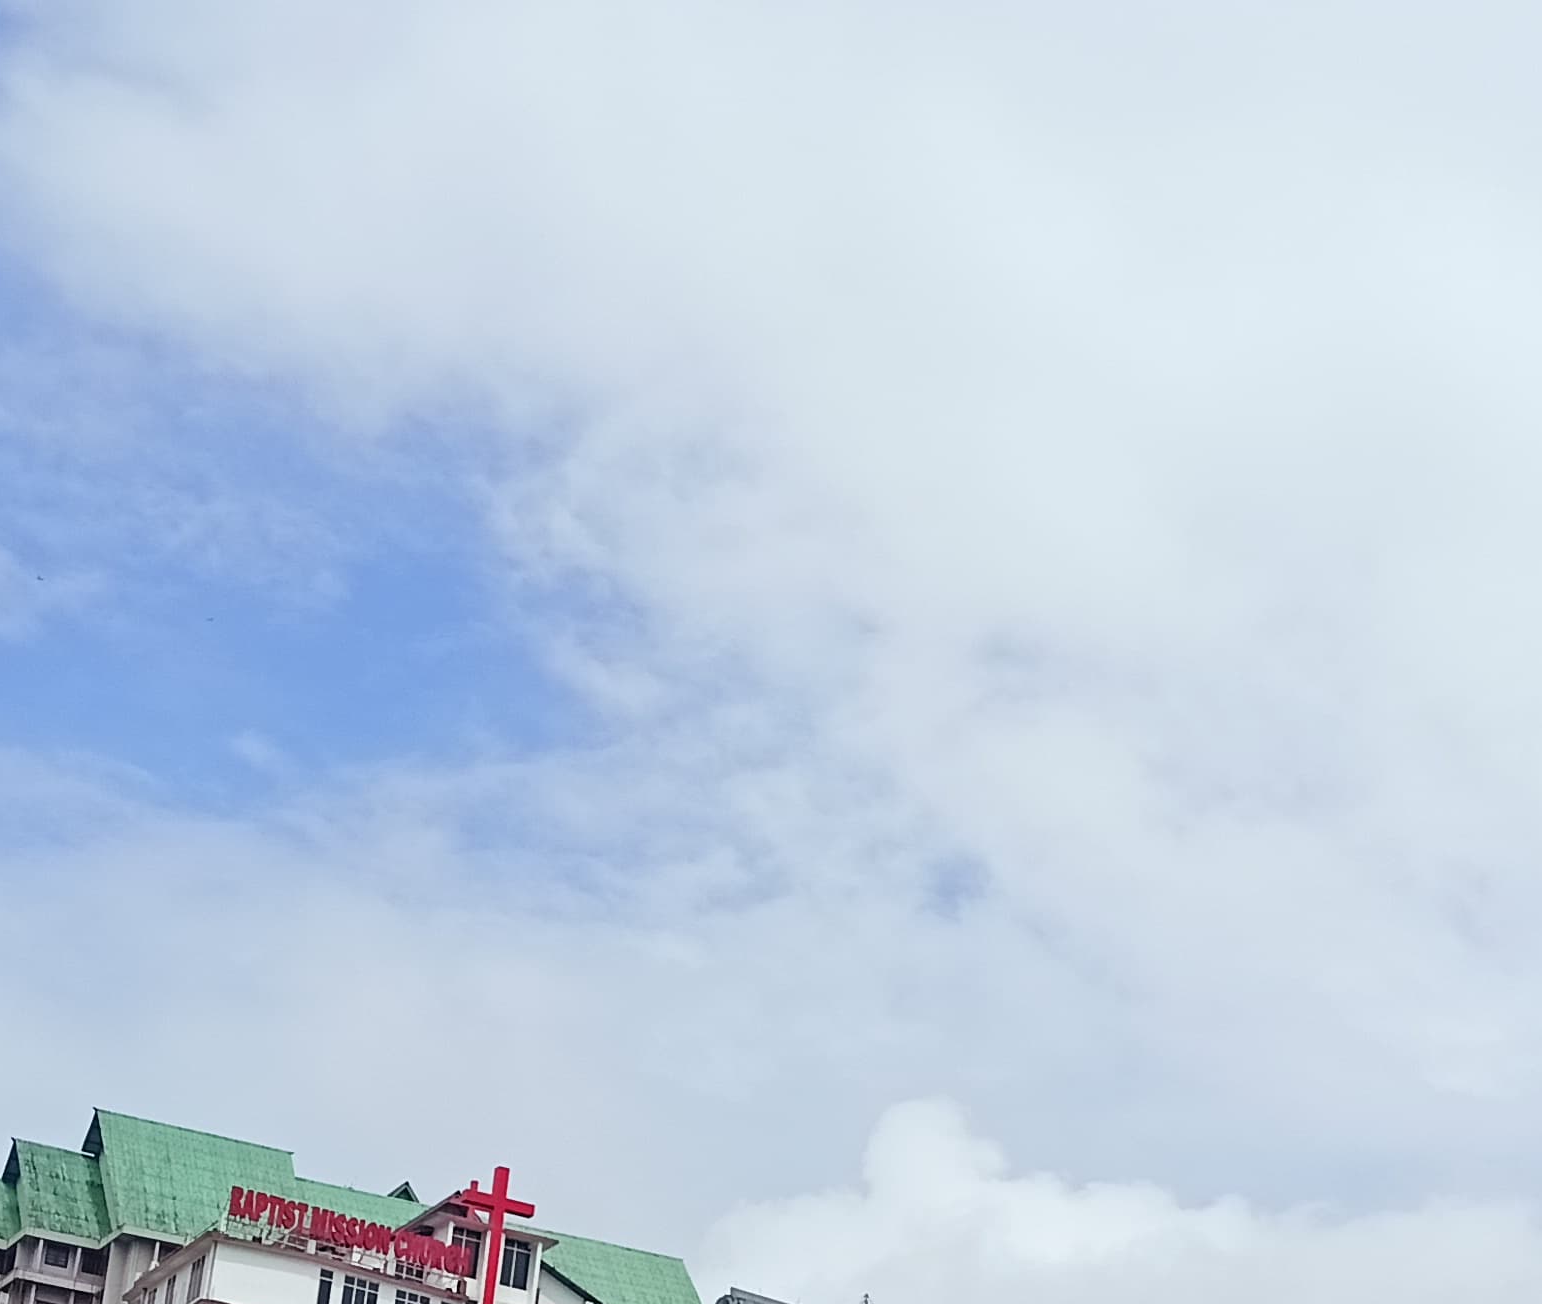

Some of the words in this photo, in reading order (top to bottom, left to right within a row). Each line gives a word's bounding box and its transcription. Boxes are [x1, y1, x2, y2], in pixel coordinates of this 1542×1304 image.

[229, 1185, 309, 1234] BAPTIST
[309, 1205, 395, 1255] MISSION
[394, 1229, 472, 1277] CHURCH
